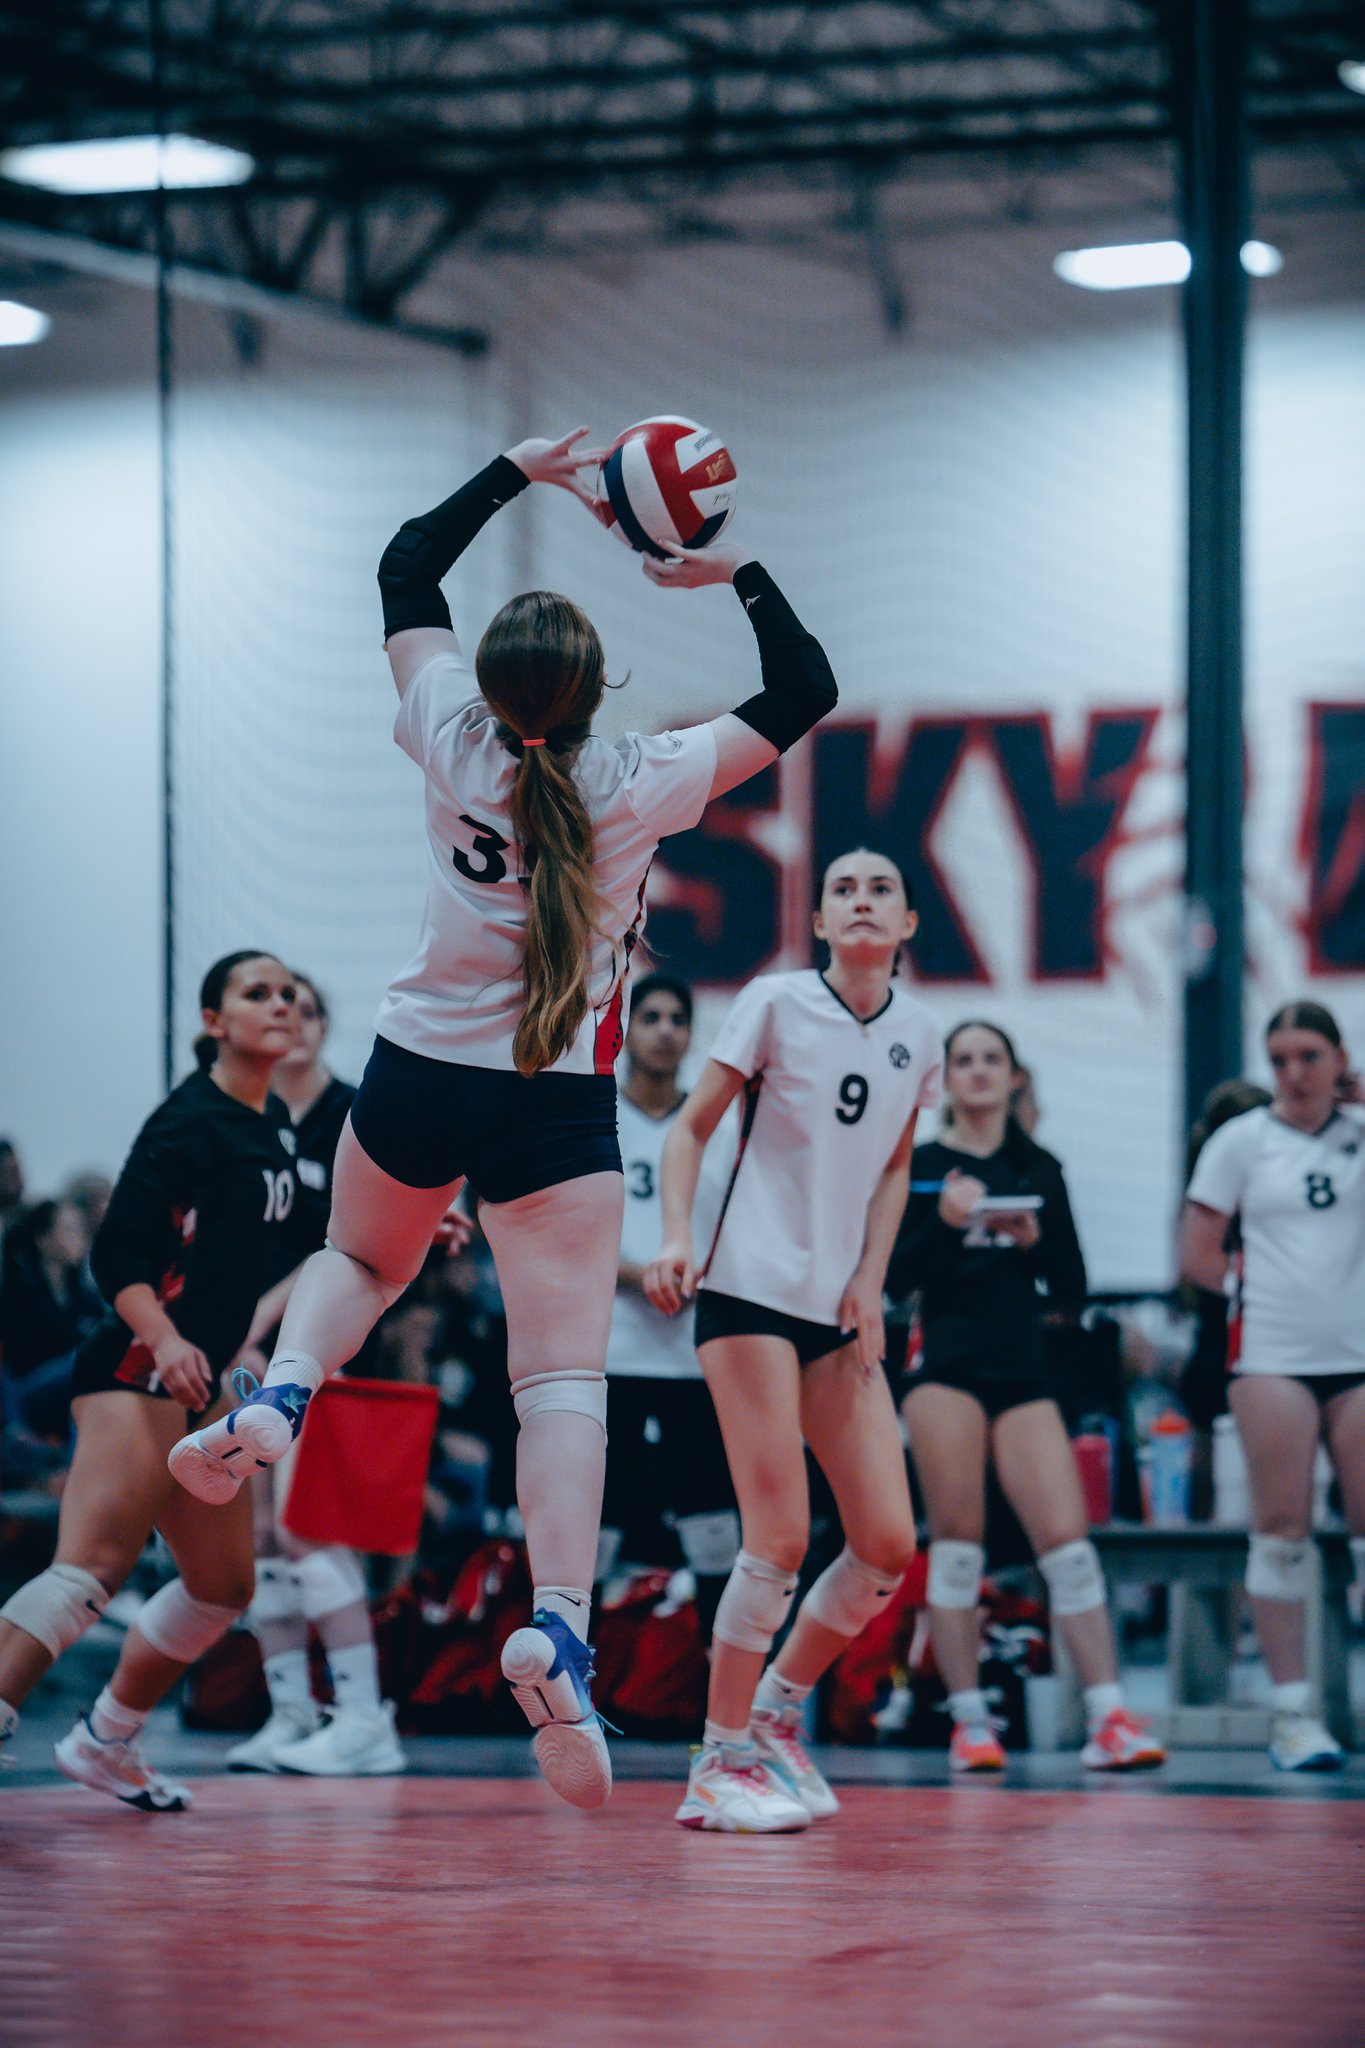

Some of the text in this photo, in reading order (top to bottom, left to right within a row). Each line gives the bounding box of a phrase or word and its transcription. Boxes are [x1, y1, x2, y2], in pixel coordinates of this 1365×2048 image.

[834, 1072, 869, 1125] 9
[262, 1168, 295, 1222] 10
[630, 1160, 654, 1201] 3
[1306, 1172, 1336, 1210] 8
